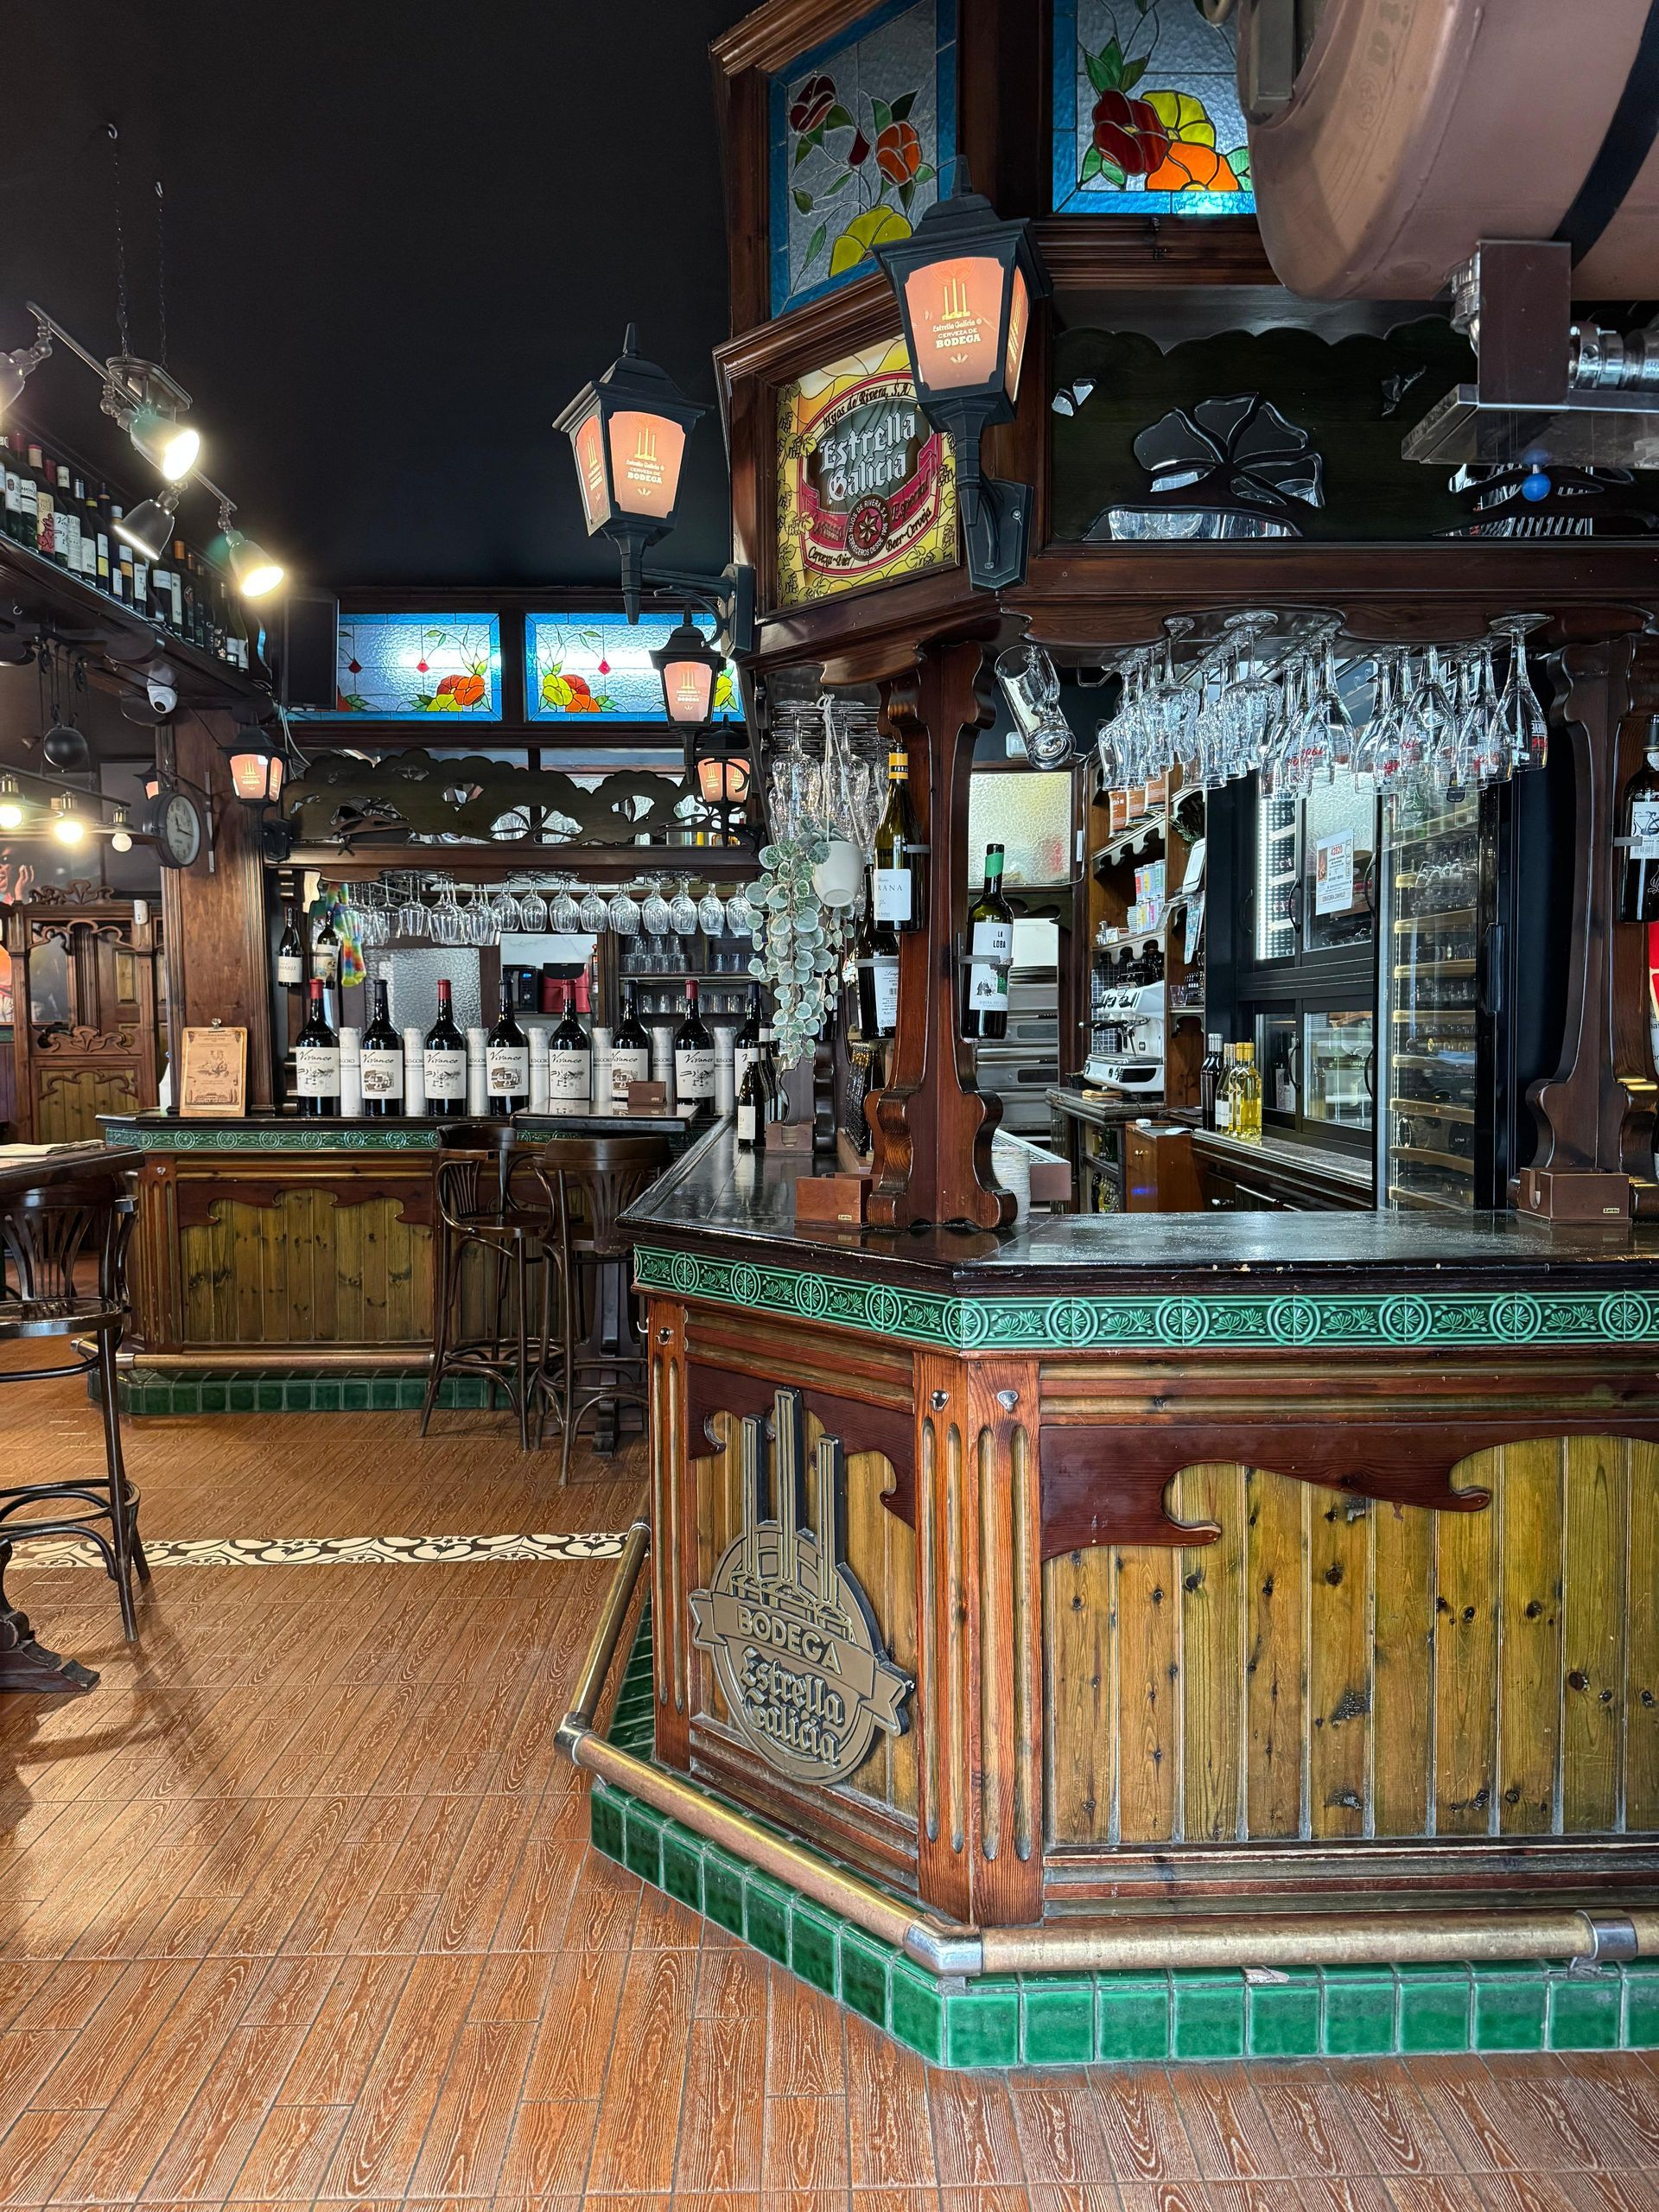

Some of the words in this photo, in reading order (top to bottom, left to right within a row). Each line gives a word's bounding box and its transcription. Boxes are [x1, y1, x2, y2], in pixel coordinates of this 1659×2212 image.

[932, 324, 955, 333] Estrella
[955, 320, 976, 329] Galicia
[936, 334, 982, 348] BODEGA
[938, 330, 968, 339] CERVEZA
[847, 397, 857, 410] de
[820, 411, 916, 470] Estrella
[627, 472, 663, 484] BODEGA
[828, 447, 907, 505] Galicia
[849, 512, 858, 532] HIJOS
[855, 503, 864, 512] DE
[864, 499, 881, 511] RIVERA
[869, 537, 884, 554] DESDE
[993, 939, 1007, 949] LOBA
[299, 1049, 332, 1062] Vivanco
[362, 1052, 394, 1065] Vivanco
[427, 1052, 459, 1064] Vivanco
[490, 1049, 522, 1061] Vivanco
[552, 1052, 582, 1064] Vivanco
[737, 1604, 842, 1675] BODEGA
[740, 1645, 845, 1726] Estrella
[743, 1688, 840, 1769] Galicia
